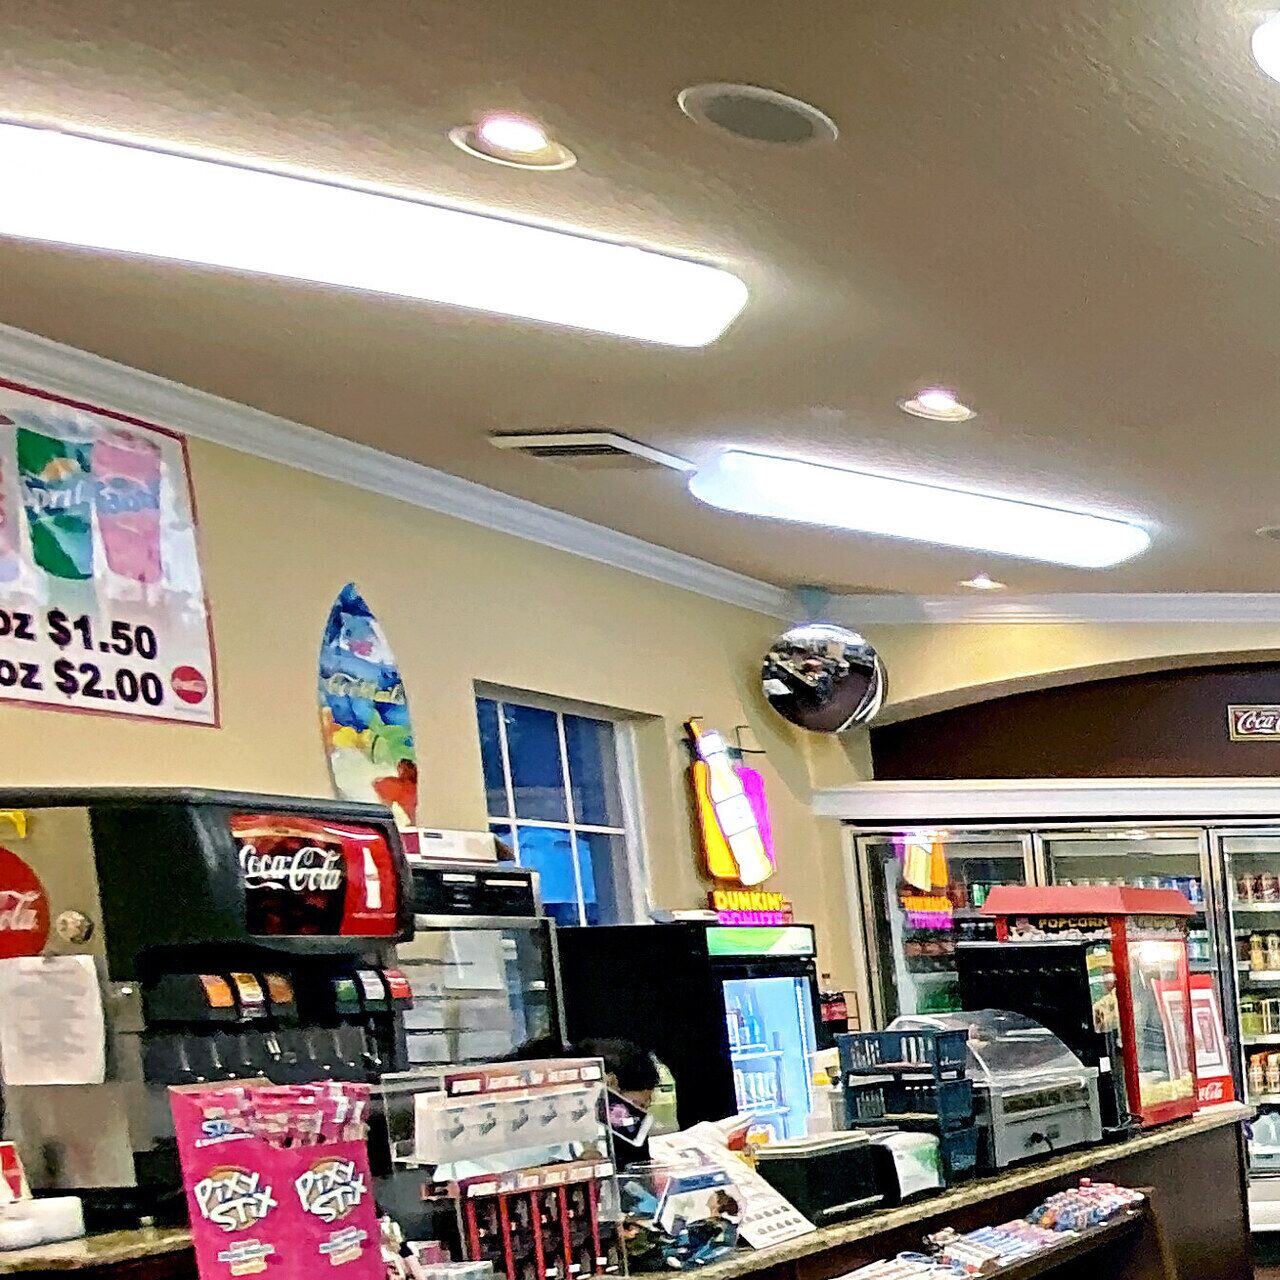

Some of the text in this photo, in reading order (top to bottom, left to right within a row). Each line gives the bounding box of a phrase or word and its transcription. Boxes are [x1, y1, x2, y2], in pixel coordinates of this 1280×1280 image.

[47, 606, 158, 660] $1.50
[54, 656, 164, 706] $2.00
[239, 843, 344, 892] Coca-Cola
